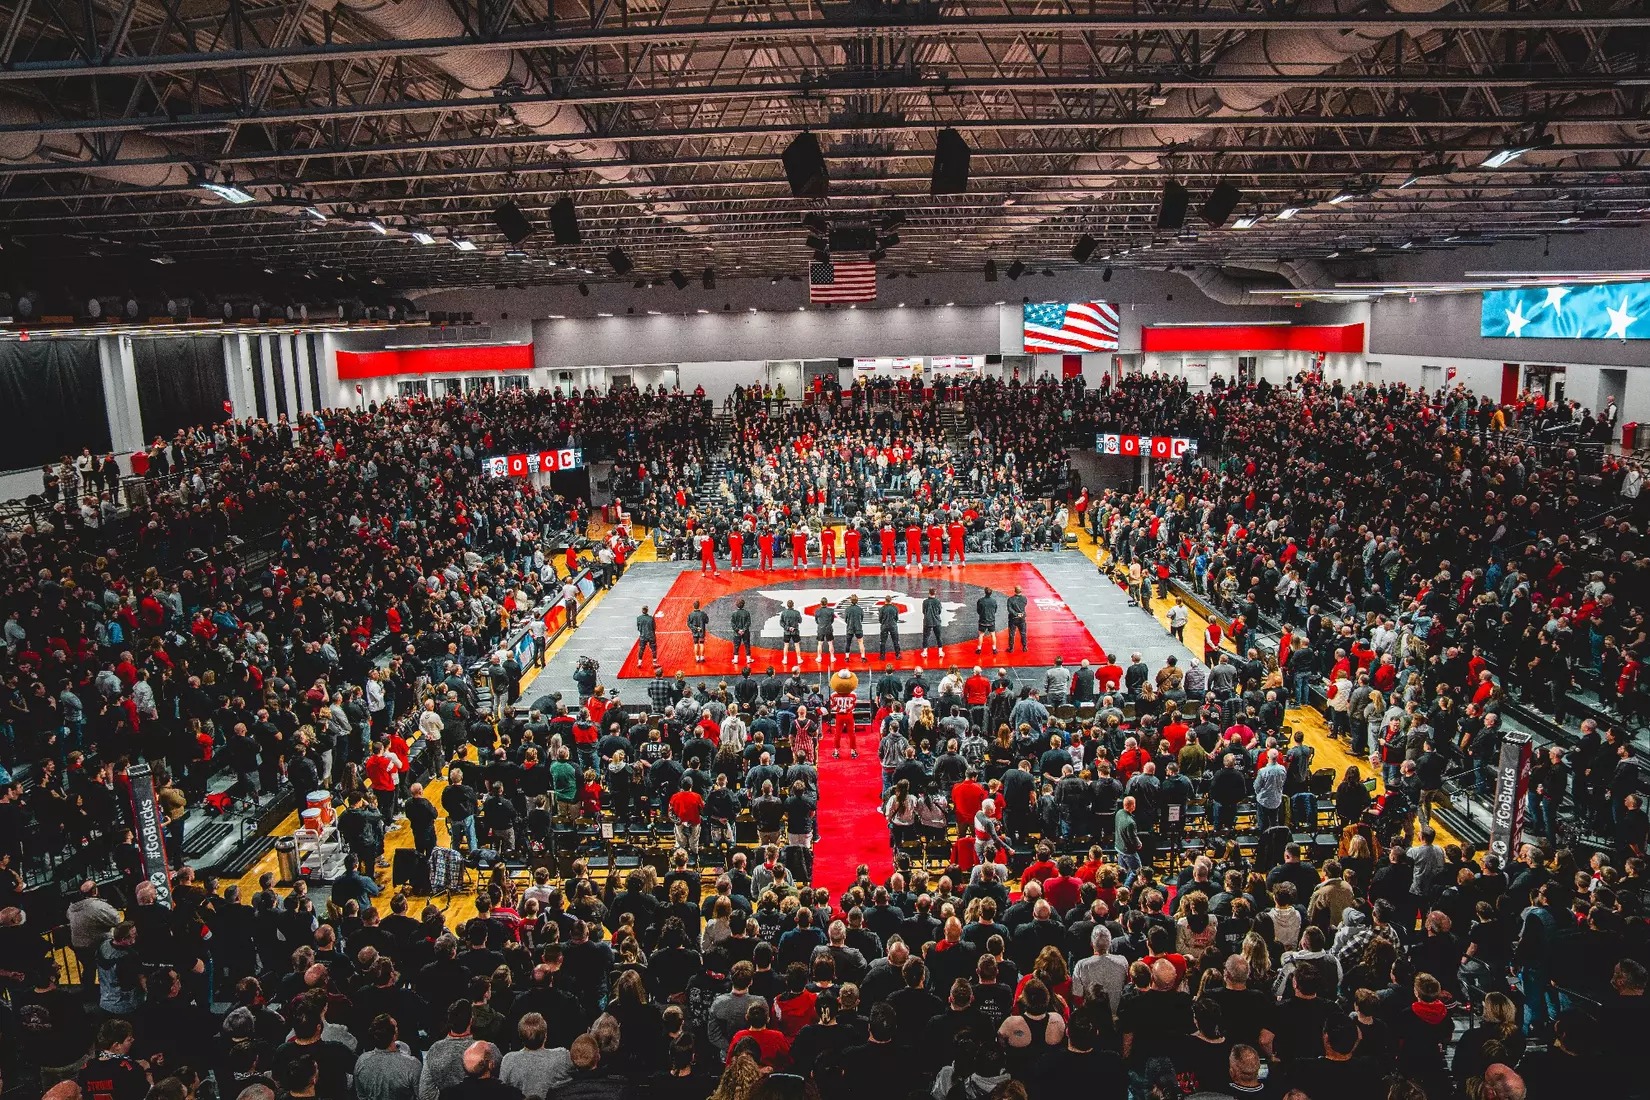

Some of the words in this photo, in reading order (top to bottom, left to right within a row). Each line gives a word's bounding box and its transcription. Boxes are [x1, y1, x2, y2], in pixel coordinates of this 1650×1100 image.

[1125, 439, 1134, 451] 0
[1157, 441, 1166, 453] 0
[513, 459, 522, 471] 0
[545, 455, 554, 467] 0
[646, 744, 663, 752] USA
[1496, 767, 1516, 829] #GoBucks
[141, 799, 161, 859] #GoBucks
